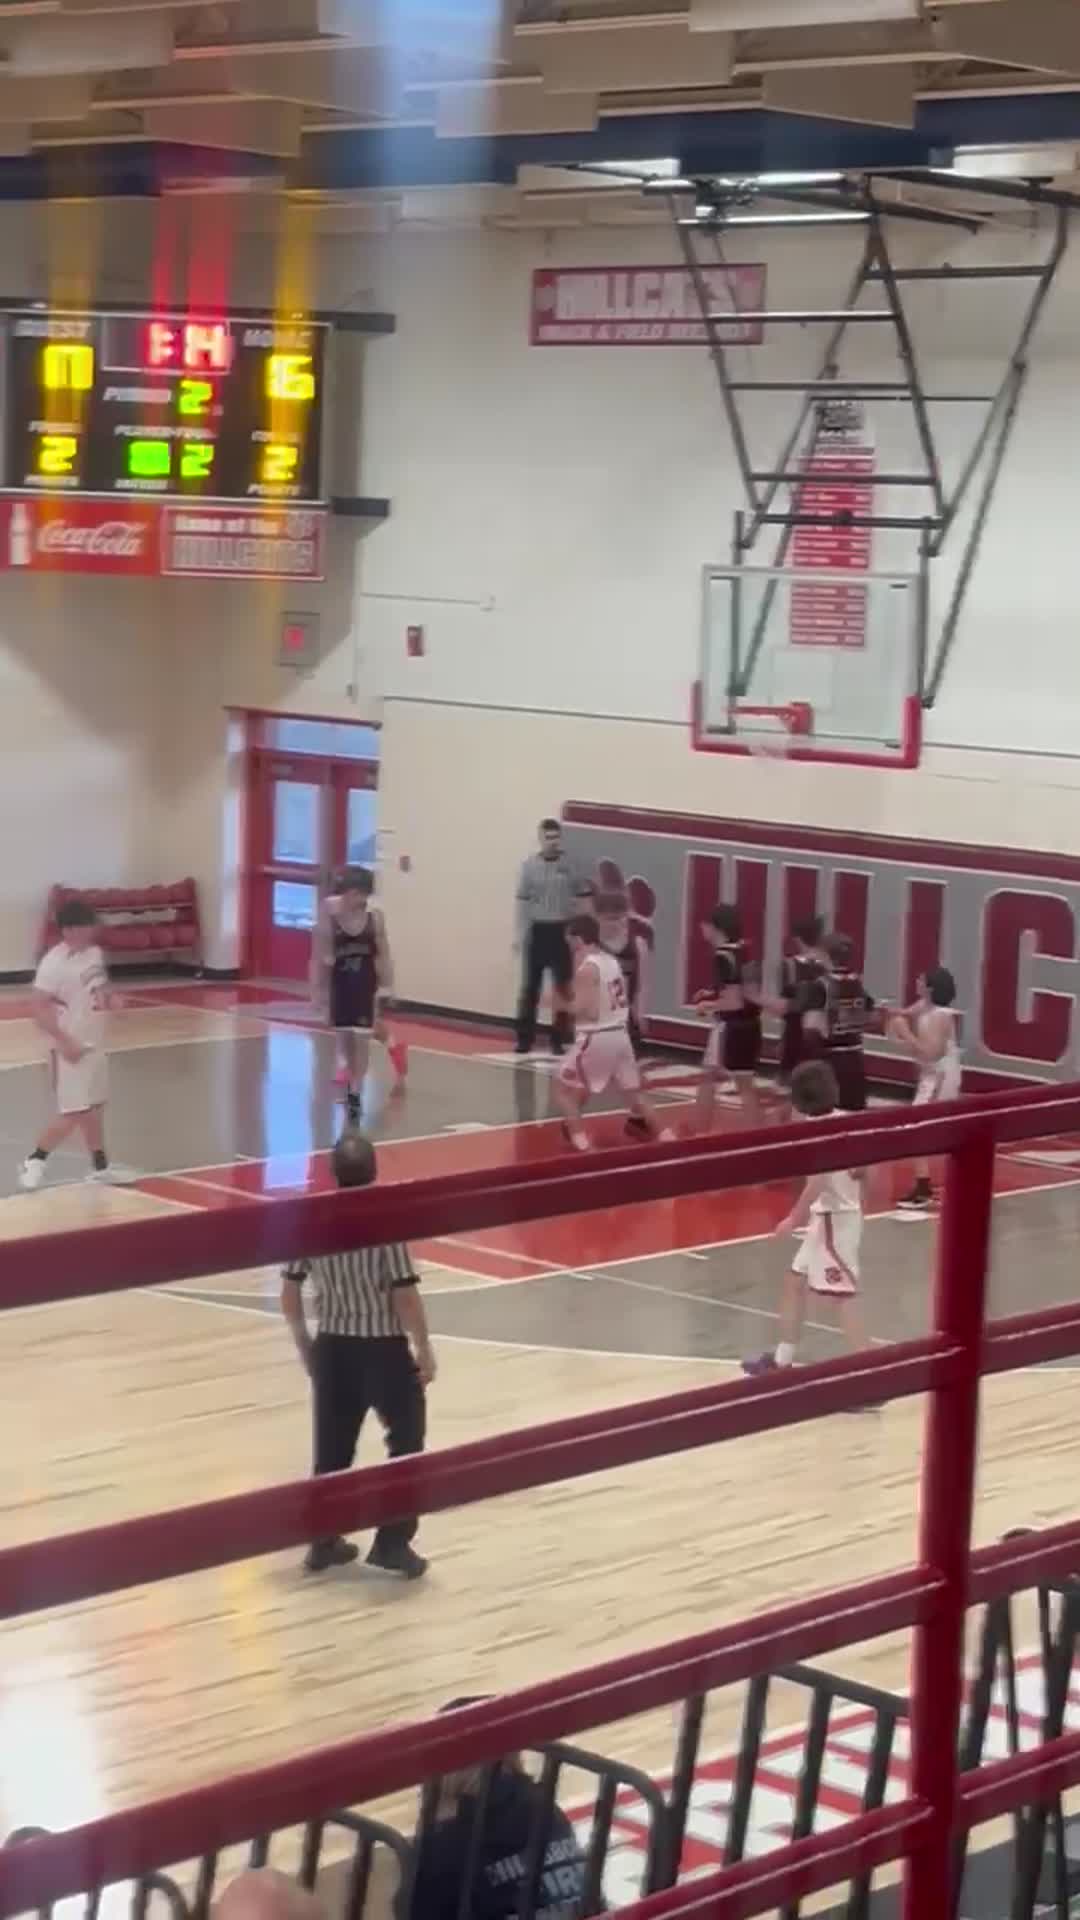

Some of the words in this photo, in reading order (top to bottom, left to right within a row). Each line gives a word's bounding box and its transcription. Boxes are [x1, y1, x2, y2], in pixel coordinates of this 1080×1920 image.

[179, 379, 212, 414] 2
[40, 436, 77, 472] 2
[180, 444, 214, 477] 2
[262, 447, 298, 480] 2
